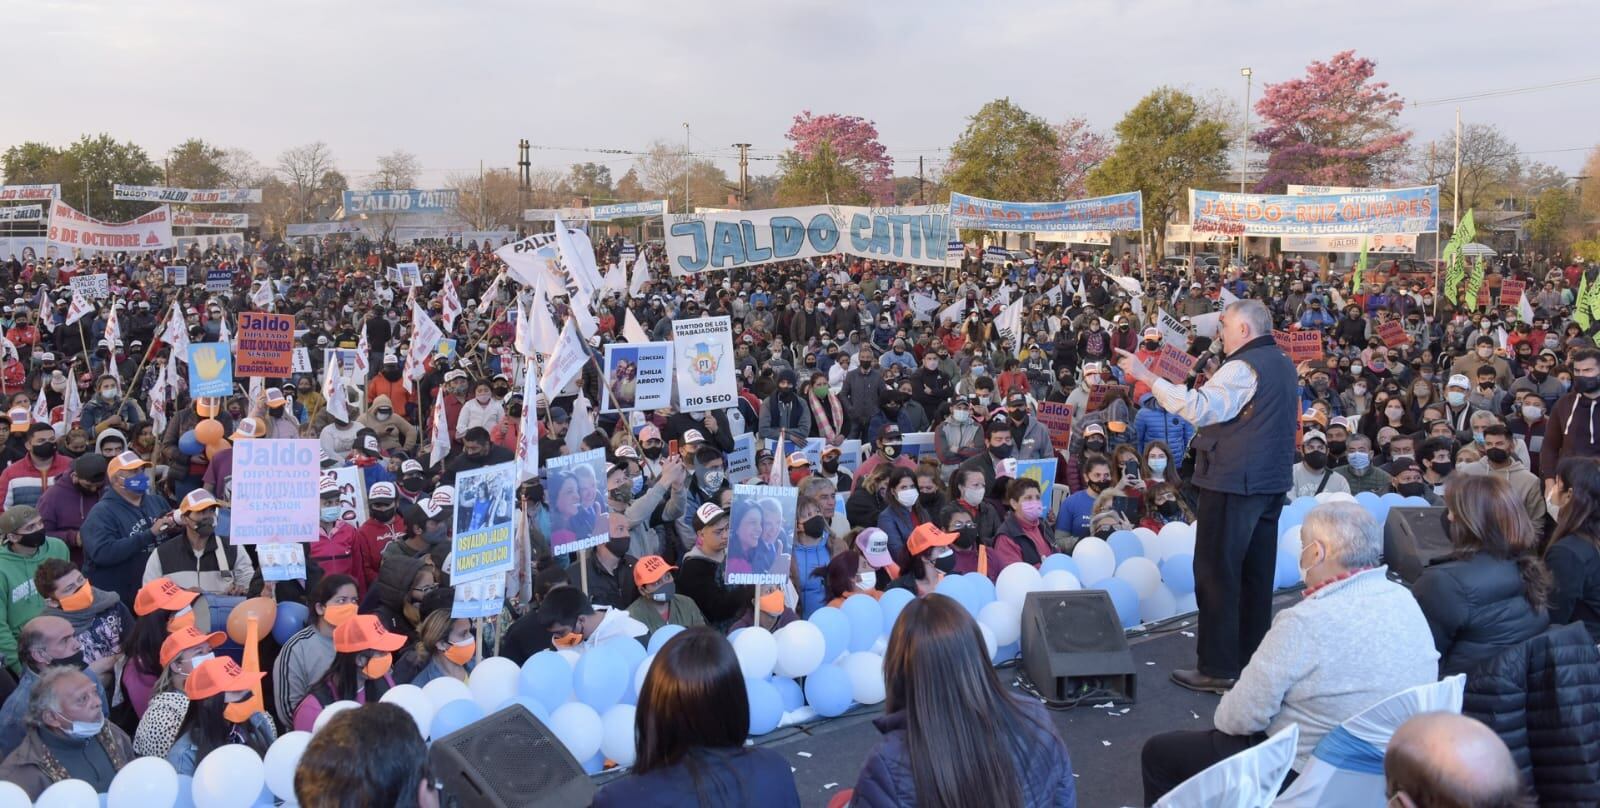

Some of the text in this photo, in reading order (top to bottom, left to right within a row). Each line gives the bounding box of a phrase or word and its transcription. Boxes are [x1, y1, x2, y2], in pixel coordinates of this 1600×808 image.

[18, 189, 52, 198] SANCHEZ
[159, 190, 188, 200] JALDO
[191, 193, 219, 202] JALDO
[1340, 195, 1387, 204] ANTONIO
[1065, 201, 1102, 209] ANTONIO
[1201, 198, 1432, 222] JALDO RUIZ OLIVARES
[14, 209, 41, 220] JALDO
[1286, 225, 1308, 233] POR
[61, 228, 79, 243] DE
[82, 231, 140, 247] OCTUBRE
[671, 213, 840, 272] JALDO
[241, 315, 290, 332] Jaldo
[1162, 314, 1186, 335] PALINA
[676, 326, 728, 336] TRABAJADORES
[1292, 331, 1318, 342] Jaldo
[240, 340, 290, 352] RUIZ OLIVARES
[1164, 345, 1192, 367] Jaldo
[699, 360, 709, 369] PT
[686, 394, 732, 406] RIO SECO
[1038, 402, 1070, 416] Jaldo
[238, 442, 312, 466] Jaldo
[546, 448, 605, 469] NANCY BULACIO
[730, 458, 748, 466] EMILIA
[243, 470, 310, 478] DIPUTADO
[728, 464, 751, 474] ARROYO
[237, 481, 316, 500] RUIZ OLIVARES
[734, 484, 796, 496] NANCY BULACIO
[249, 502, 301, 510] SENADOR
[234, 524, 313, 537] SERGIO MURAY
[457, 526, 508, 552] OSVALDO JALDO
[554, 532, 610, 556] CONDUCCION
[456, 545, 508, 573] NANCY BULACIO
[728, 573, 787, 584] CONDUCCION
